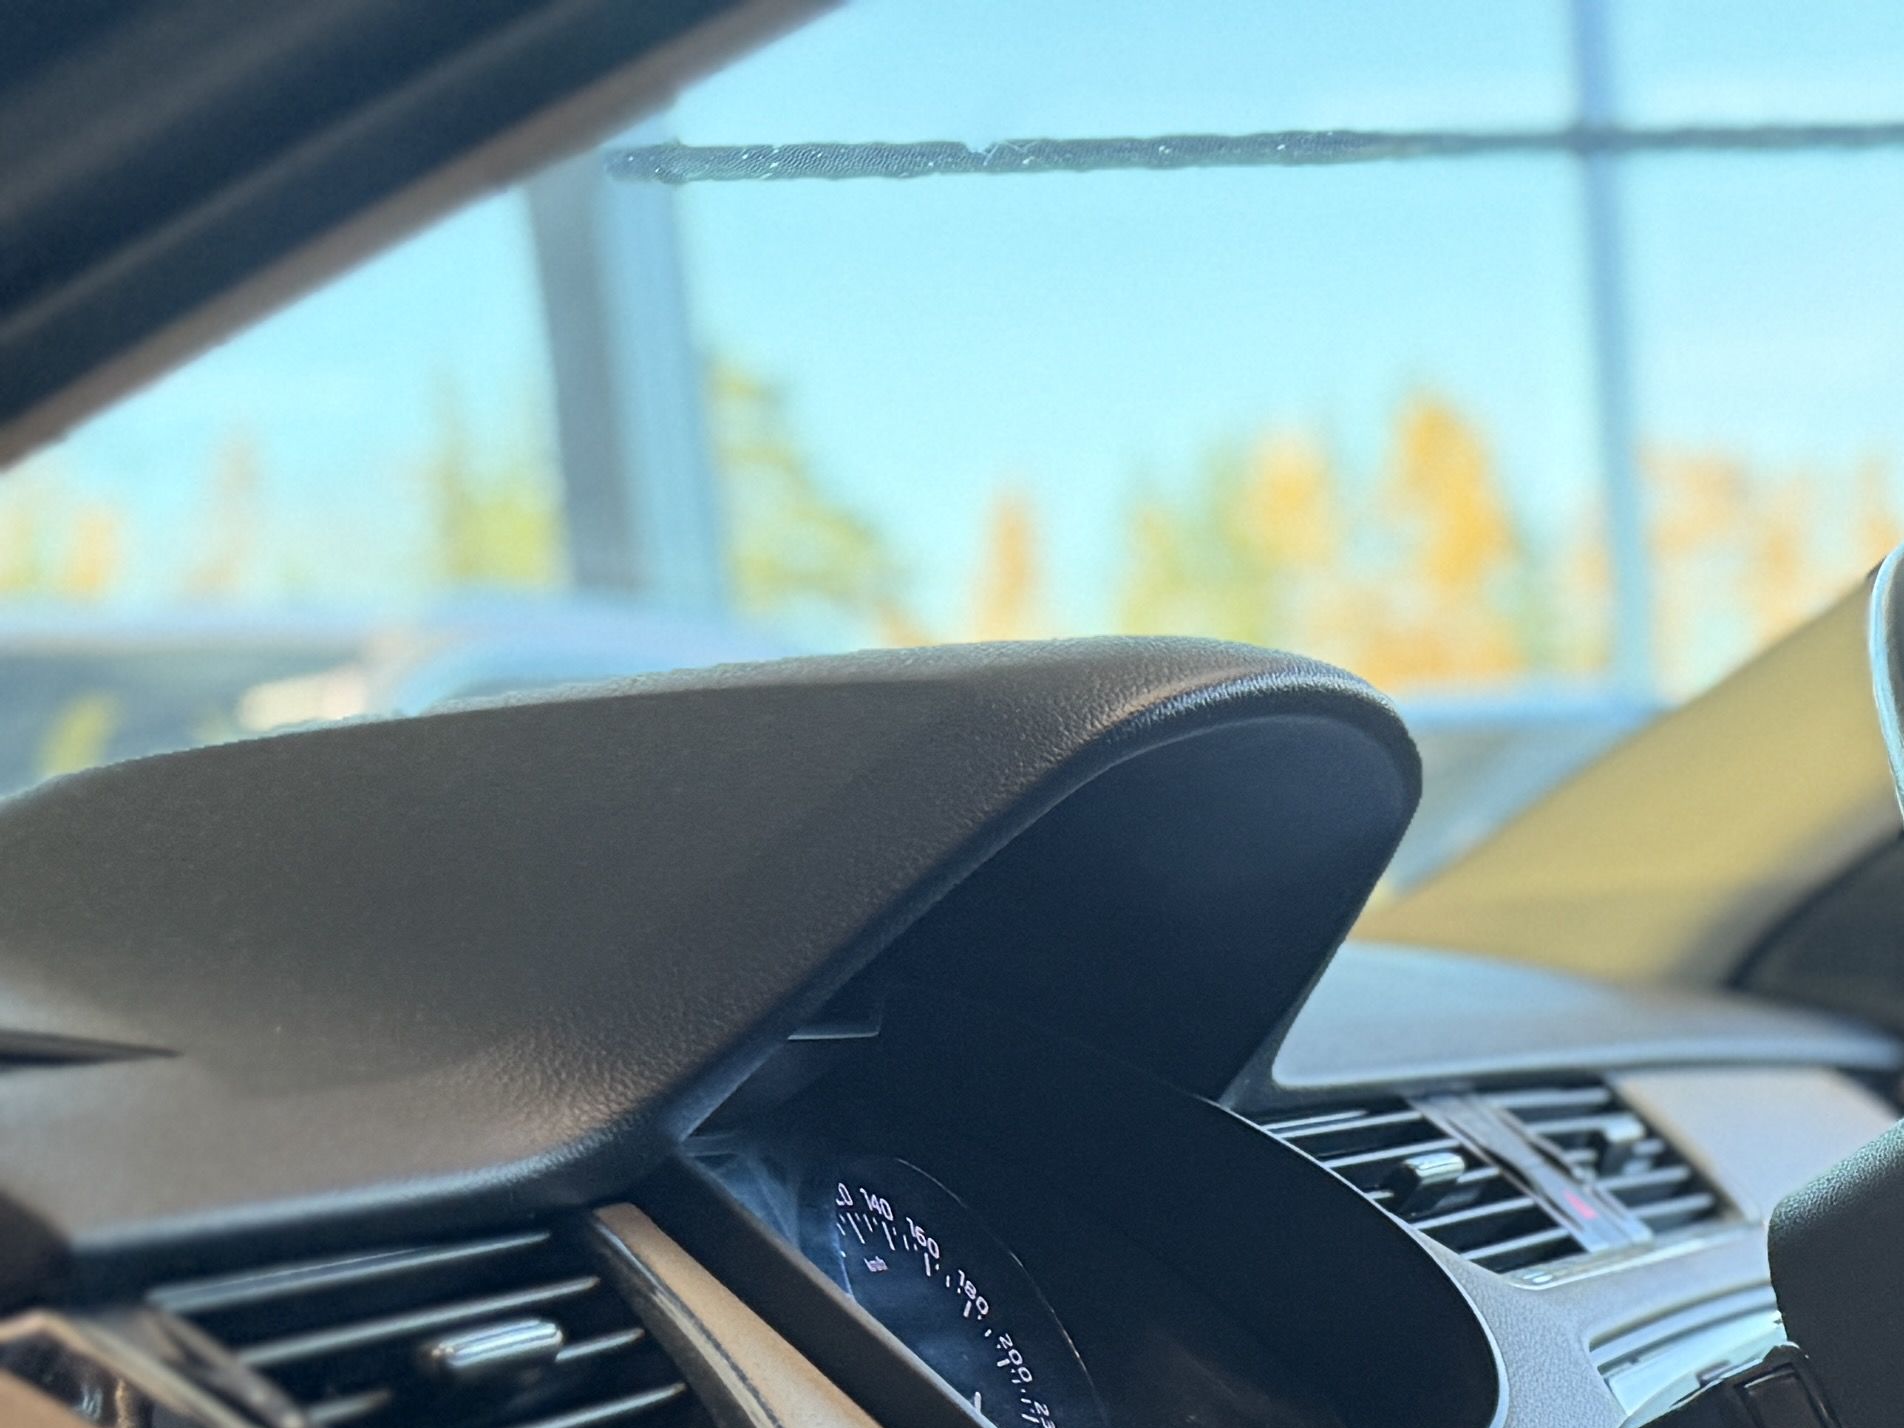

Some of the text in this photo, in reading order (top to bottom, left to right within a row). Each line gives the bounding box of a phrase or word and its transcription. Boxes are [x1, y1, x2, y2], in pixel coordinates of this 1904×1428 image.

[860, 1187, 894, 1221] 140
[906, 1217, 940, 1259] 160
[958, 1269, 989, 1316] 180
[998, 1333, 1033, 1384] 200
